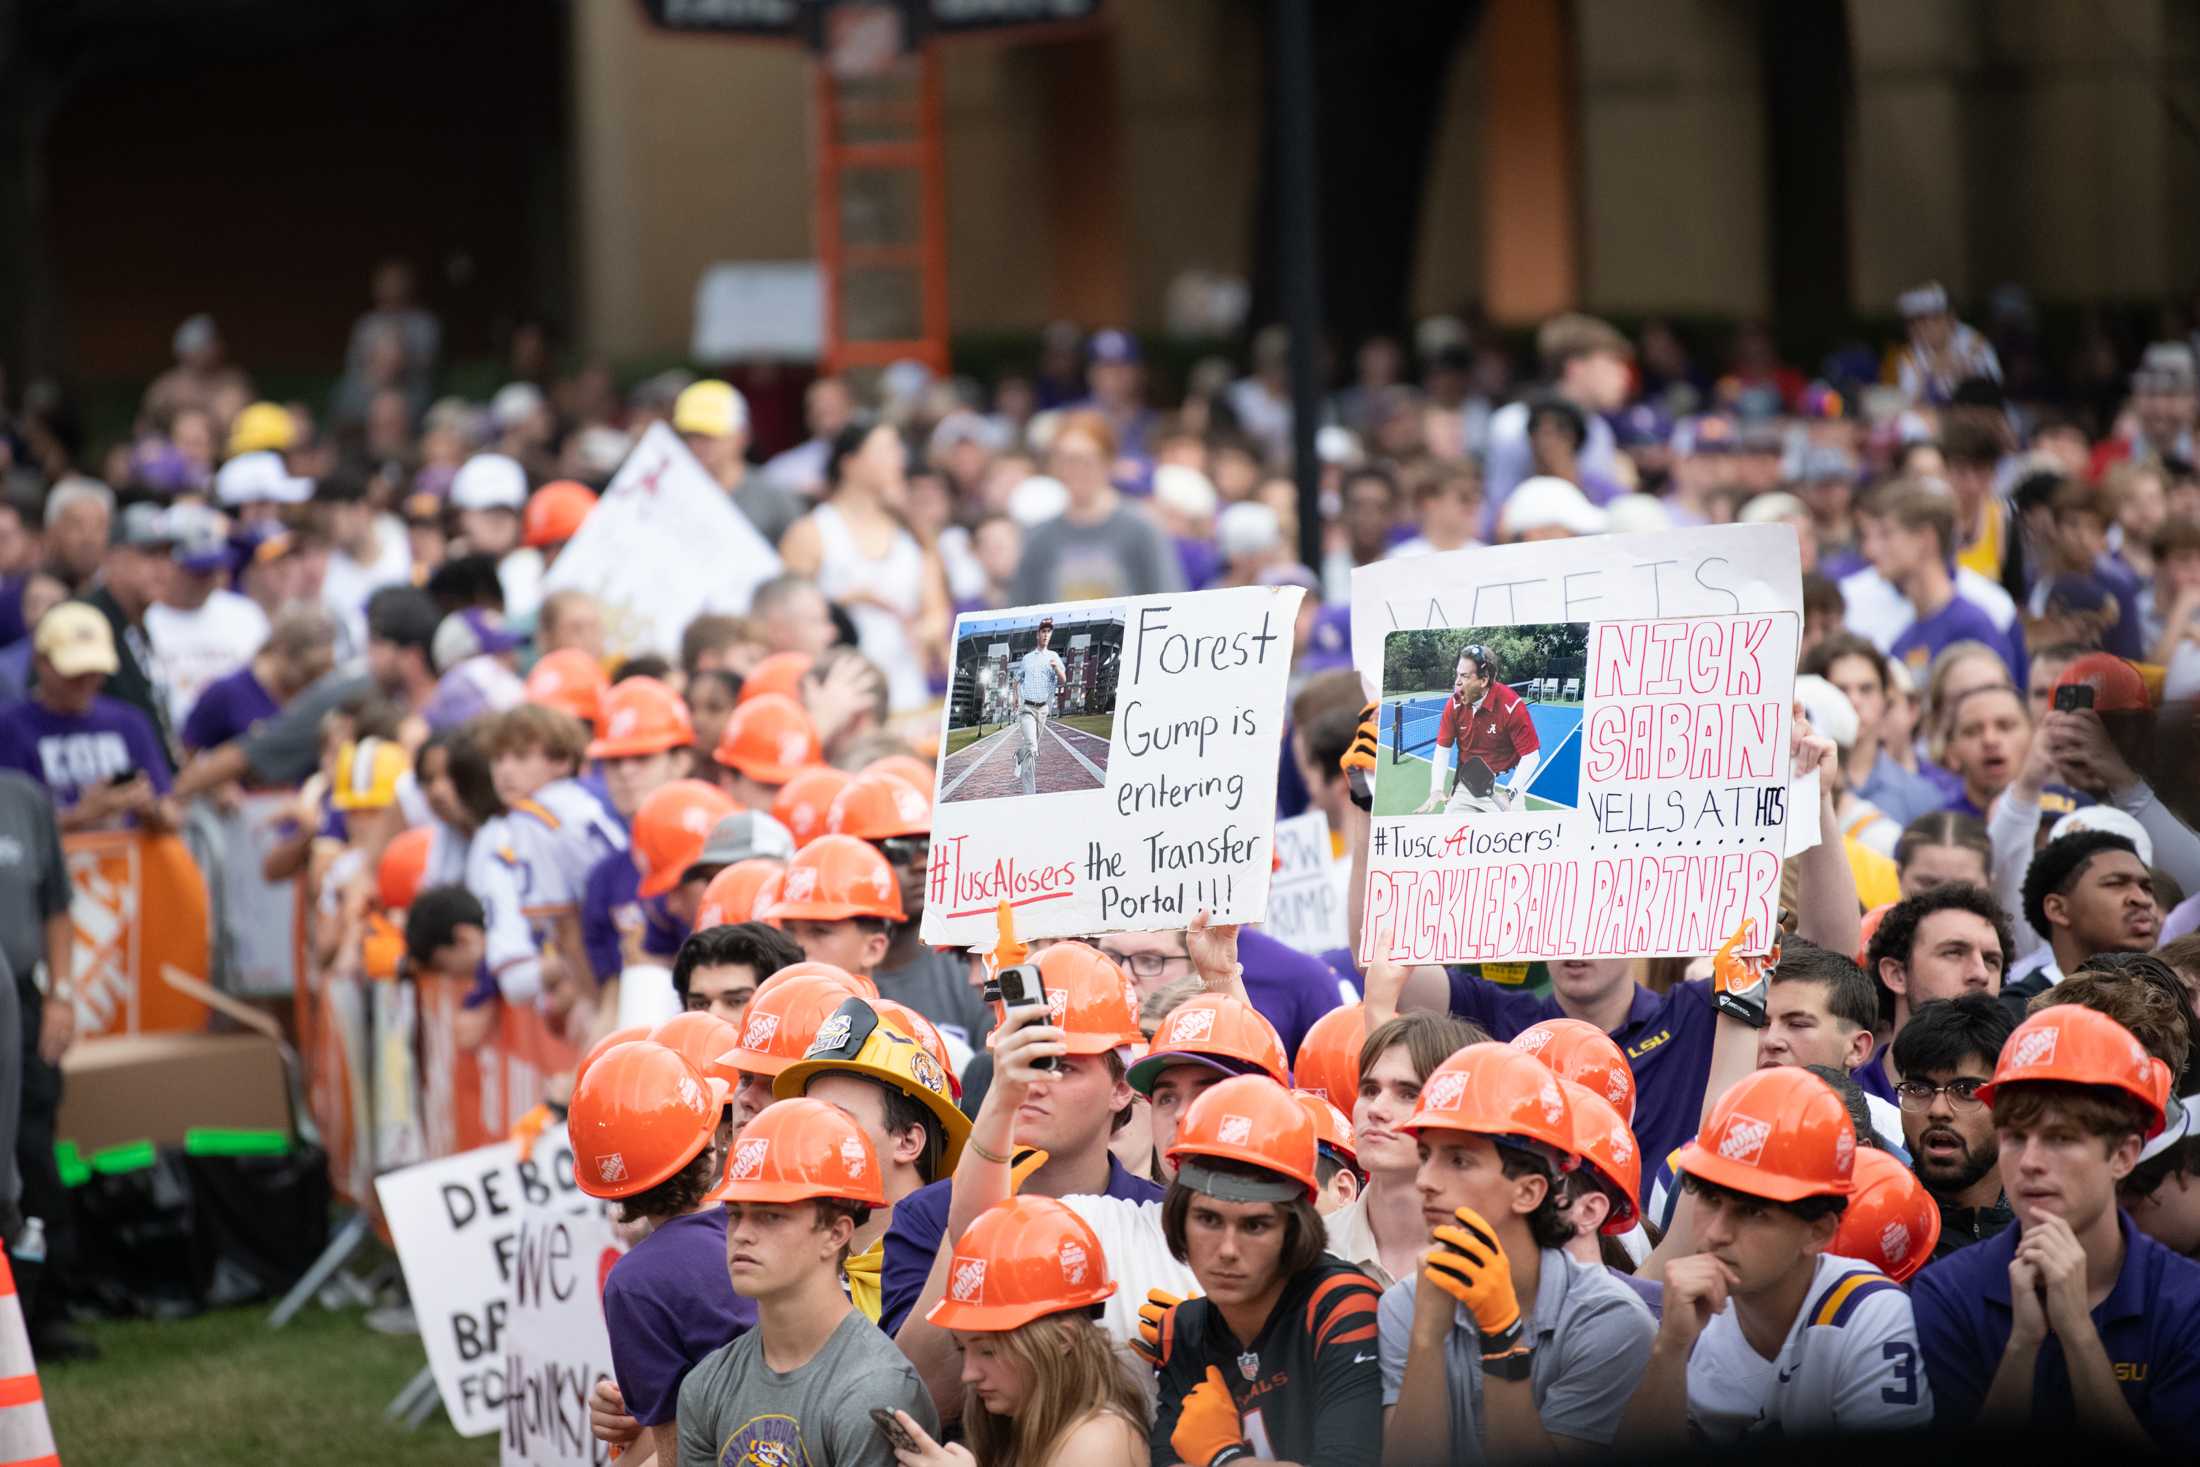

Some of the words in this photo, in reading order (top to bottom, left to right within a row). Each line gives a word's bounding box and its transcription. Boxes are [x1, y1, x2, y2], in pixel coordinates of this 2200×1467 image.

[1134, 606, 1277, 685] Forest
[1595, 617, 1773, 697] NICK
[1124, 701, 1218, 757] Gump
[1232, 705, 1256, 736] is
[1587, 703, 1780, 782] SABAN
[1118, 773, 1243, 816] entering
[1588, 791, 1686, 835] YELLS
[1693, 786, 1754, 829] AT
[1754, 785, 1785, 827] HIS
[929, 835, 1075, 909] #TuscAlosers
[1084, 841, 1126, 882] the
[1143, 825, 1260, 874] Transfer
[1101, 883, 1184, 921] Portal
[1361, 861, 1578, 963] PICKLEBALL
[1583, 850, 1779, 956] PARTNER
[1627, 1030, 1671, 1058] LSU
